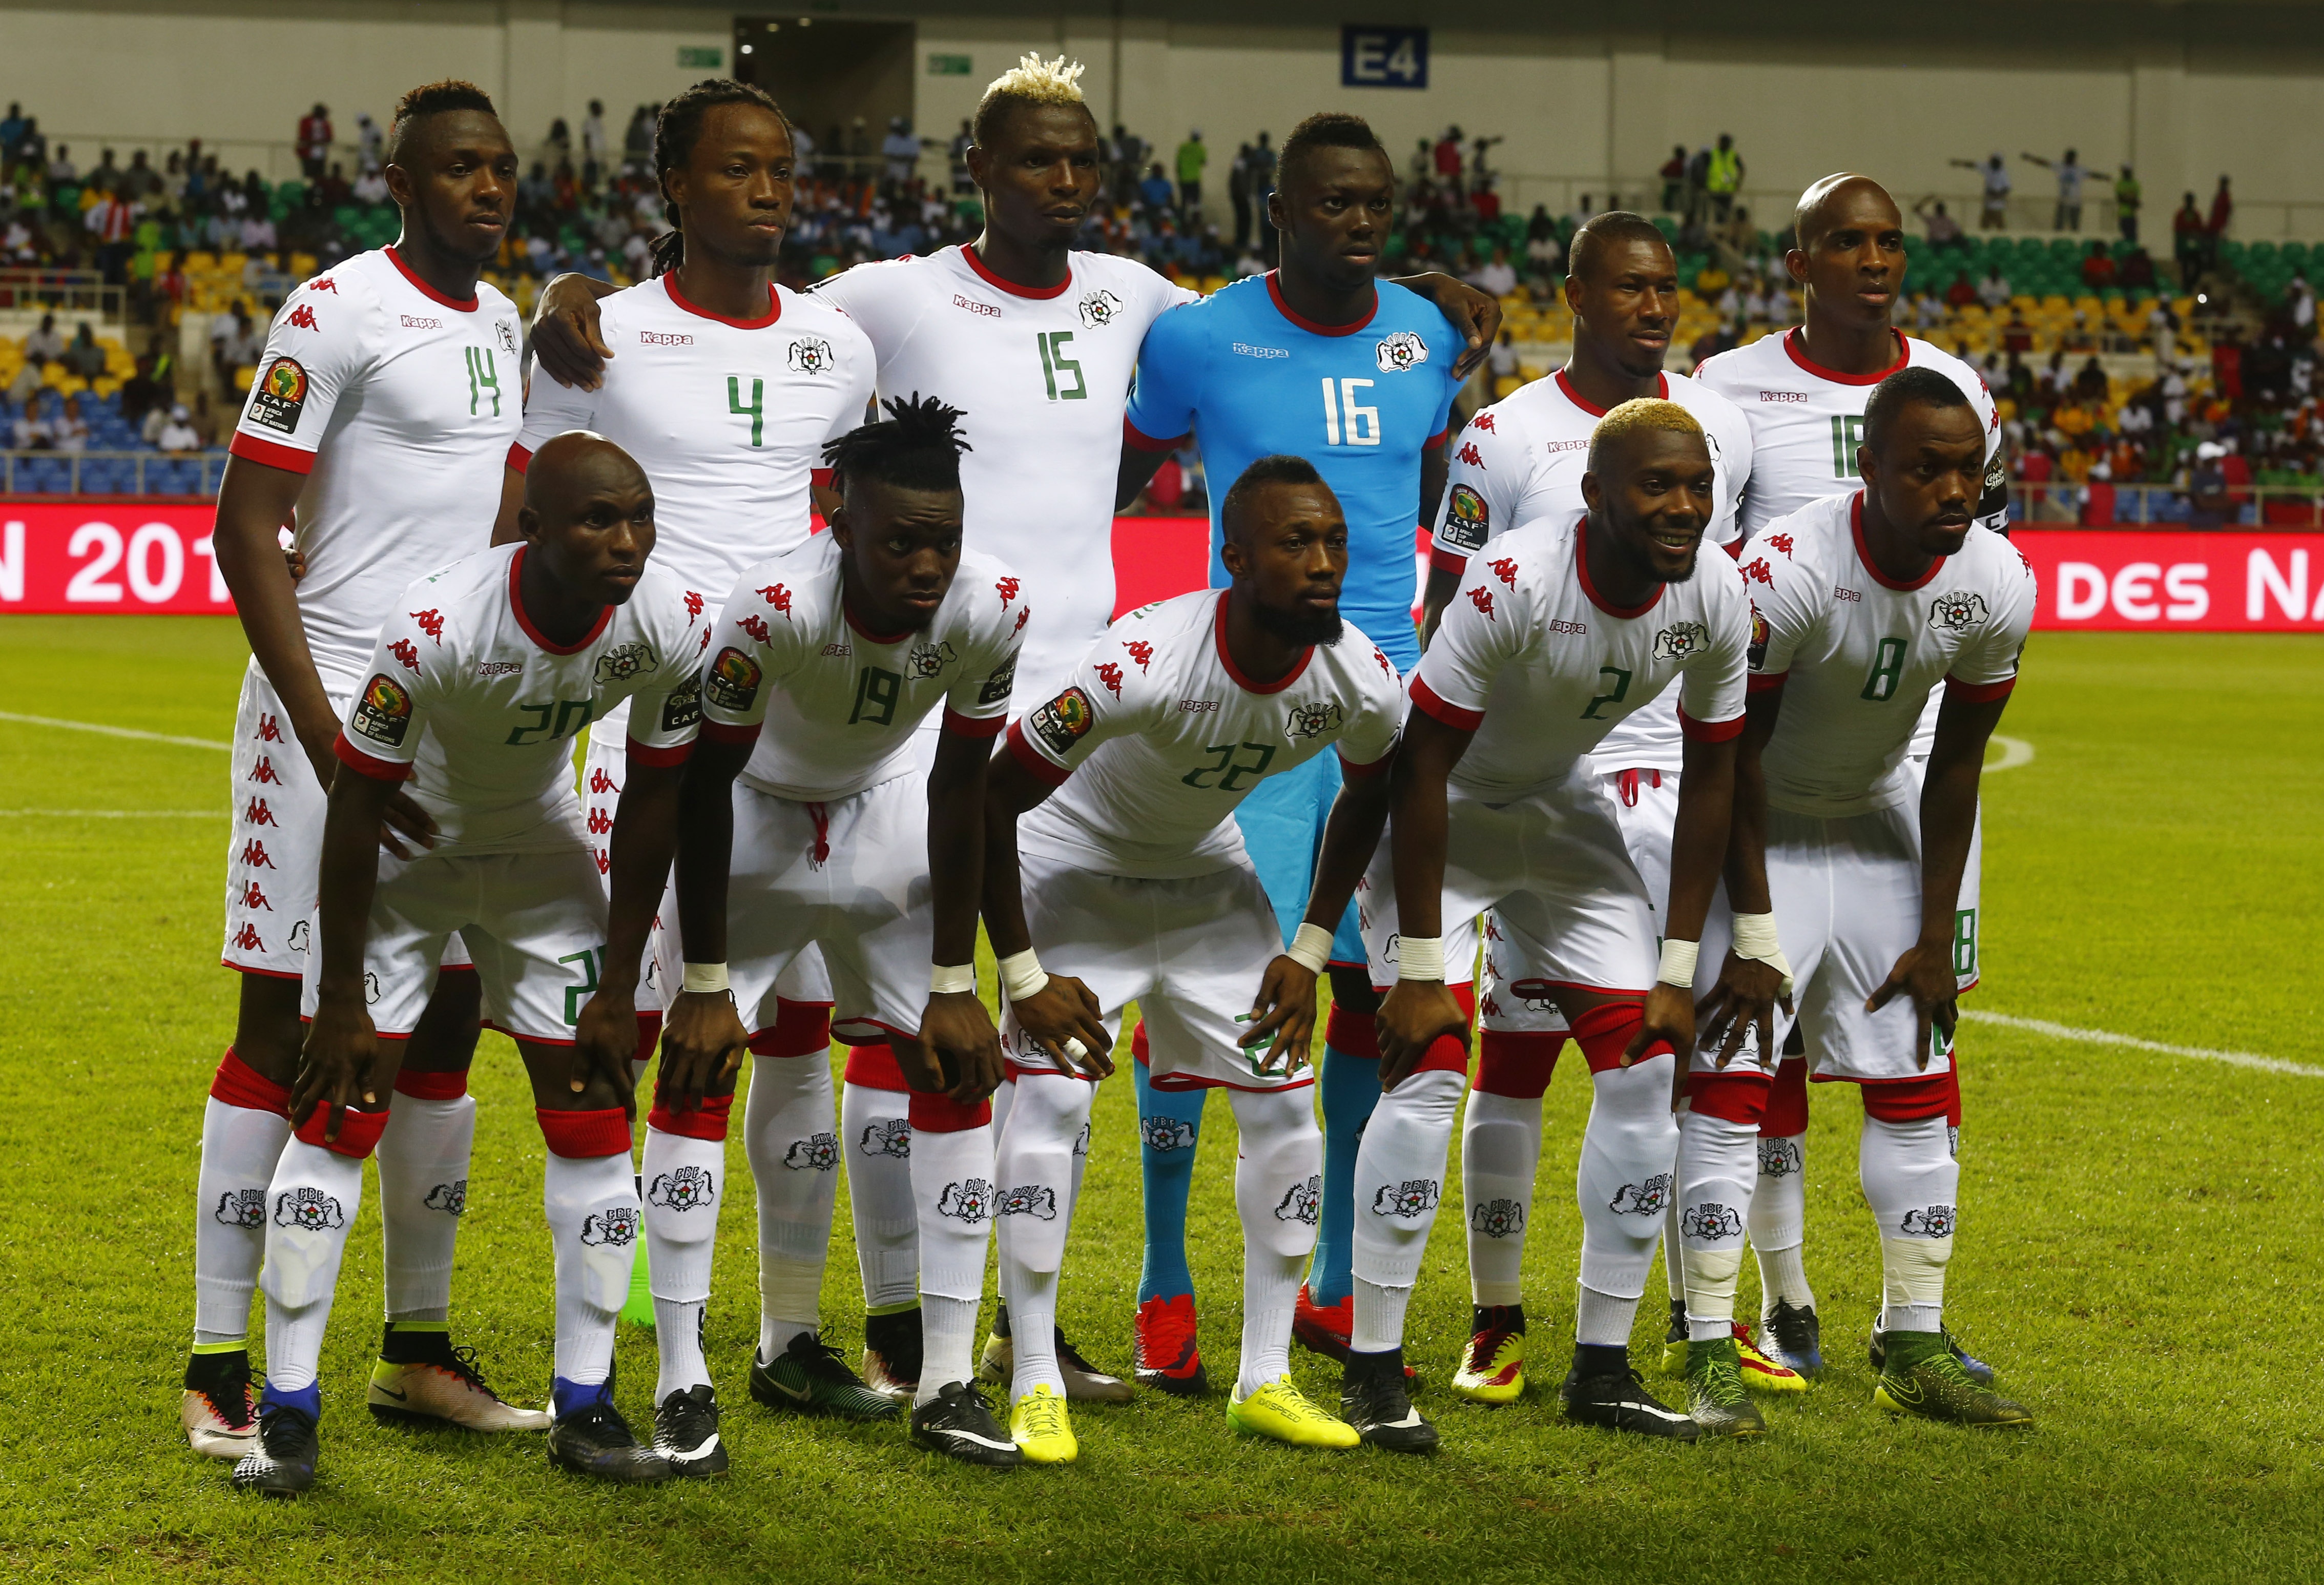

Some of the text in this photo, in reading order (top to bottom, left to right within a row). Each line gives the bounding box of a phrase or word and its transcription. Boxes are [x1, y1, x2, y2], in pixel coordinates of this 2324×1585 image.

[1353, 36, 1419, 82] E4
[953, 295, 1001, 317] Kappa
[401, 315, 443, 329] Kappa
[640, 332, 693, 345] Kappa
[1233, 342, 1289, 359] Kappa
[1037, 332, 1087, 400] 15
[466, 346, 500, 417] 14
[262, 395, 292, 408] CAF
[1760, 392, 1807, 402] Kappa
[728, 377, 763, 446] 4
[1321, 377, 1380, 445] 16
[269, 419, 289, 430] NATIONS
[1455, 517, 1479, 529] CAF
[1463, 540, 1481, 549] NATIONS
[68, 522, 231, 602] 201
[2057, 547, 2324, 622] DES N
[1947, 592, 1968, 603] FBF
[1670, 622, 1693, 633] FBF
[1861, 637, 1907, 701] 8
[848, 666, 901, 726] 19
[1581, 667, 1632, 719] 2
[366, 707, 397, 722] CAF
[672, 710, 698, 725] CAF
[375, 733, 395, 744] NATIONS
[1182, 744, 1276, 792] 22
[558, 949, 606, 1026] 2
[1152, 1116, 1176, 1127] FBF
[812, 1133, 831, 1144] FBF
[1767, 1137, 1787, 1151] FBF
[675, 1166, 700, 1180] FBF
[965, 1178, 986, 1193] FBF
[1401, 1180, 1428, 1192] FBF
[1644, 1173, 1668, 1190] FBF
[241, 1189, 265, 1202] FBF
[298, 1187, 324, 1202] FBF
[1011, 1186, 1039, 1197] FBF
[1491, 1199, 1511, 1212] FBF
[1700, 1203, 1723, 1214] FBF
[1928, 1205, 1949, 1216] FBF
[607, 1208, 632, 1220] FBF
